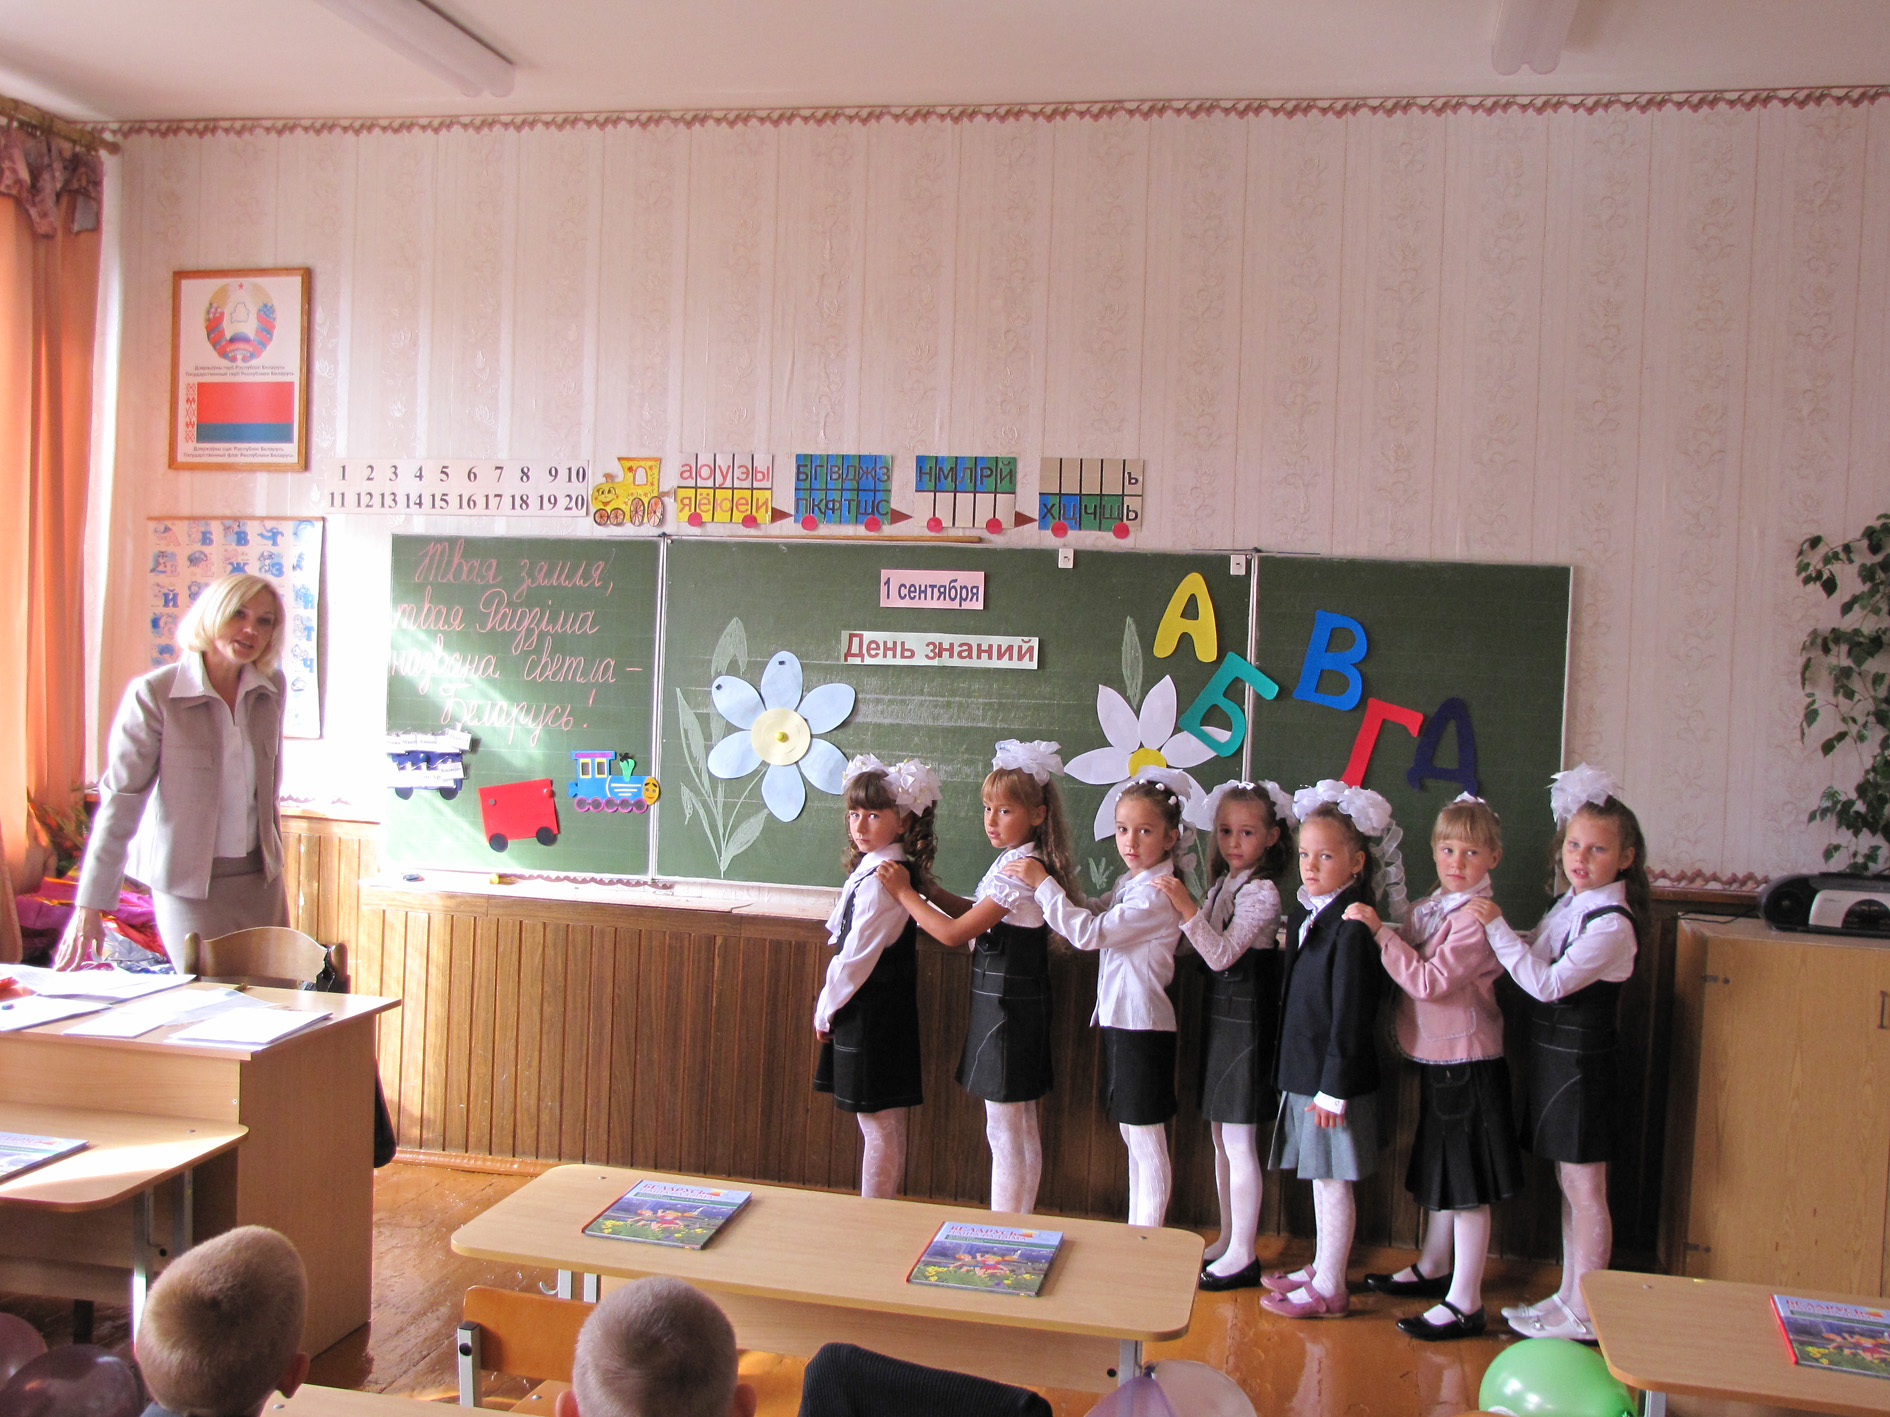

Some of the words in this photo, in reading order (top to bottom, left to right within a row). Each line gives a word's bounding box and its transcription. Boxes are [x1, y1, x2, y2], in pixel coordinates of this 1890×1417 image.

[340, 465, 347, 481] 1
[366, 465, 375, 481] 2
[389, 465, 399, 481] 3
[414, 465, 424, 482] 4
[440, 466, 450, 482] 5
[467, 466, 478, 483] 6
[494, 466, 505, 483] 7
[520, 466, 531, 483] 8
[548, 466, 559, 484] 9
[566, 466, 587, 484] 10
[329, 491, 347, 509] 11
[355, 491, 374, 509] 12
[379, 492, 398, 509] 13
[405, 492, 424, 510] 14
[430, 492, 450, 510] 15
[457, 493, 477, 510] 16
[483, 493, 504, 511] 17
[510, 493, 531, 511] 18
[537, 494, 558, 511] 19
[564, 494, 585, 511] 20
[414, 538, 502, 584] Твая
[884, 577, 891, 599] 1
[898, 579, 980, 607] сентября
[1153, 572, 1218, 663] А
[844, 633, 916, 663] День
[925, 639, 1035, 663] знаний
[1292, 609, 1368, 711] В
[1178, 652, 1280, 757] Б
[1407, 697, 1478, 797] Д
